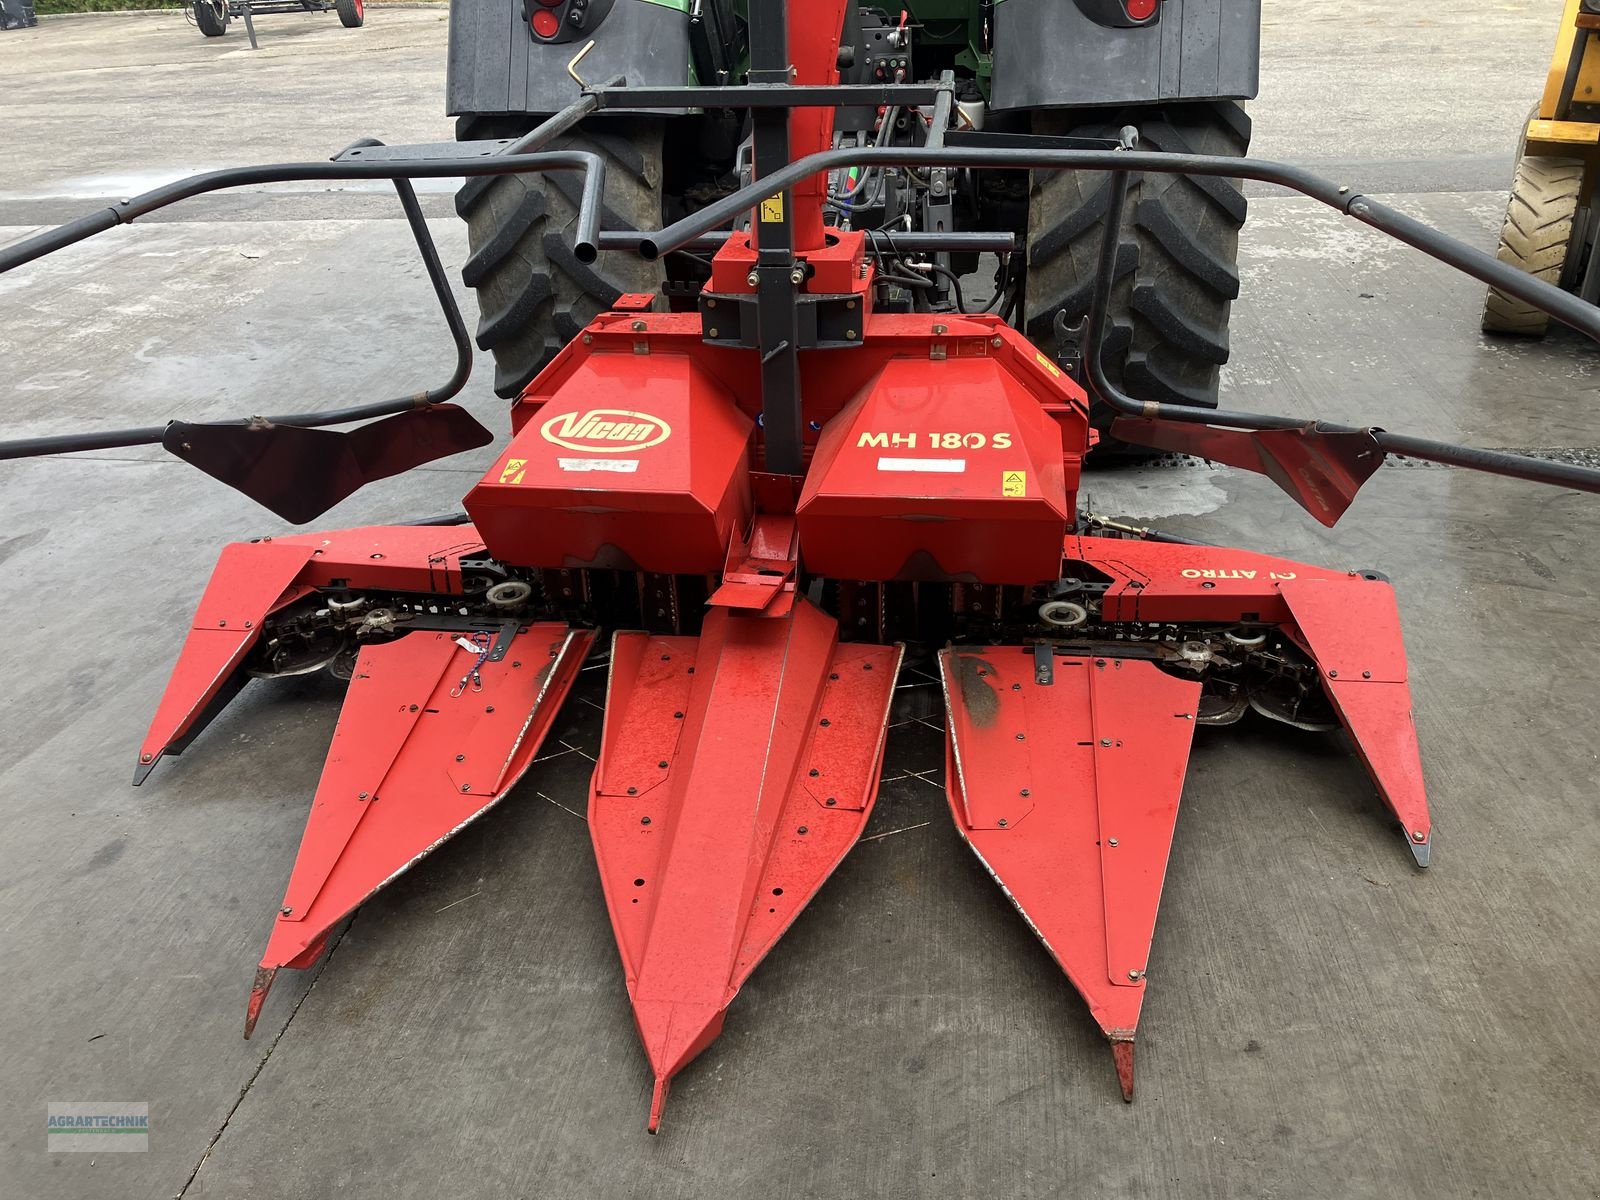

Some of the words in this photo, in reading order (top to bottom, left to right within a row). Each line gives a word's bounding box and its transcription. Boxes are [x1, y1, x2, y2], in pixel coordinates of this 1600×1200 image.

[557, 410, 656, 442] Vicon
[856, 432, 917, 448] MH
[928, 432, 987, 449] 180
[991, 432, 1013, 449] S
